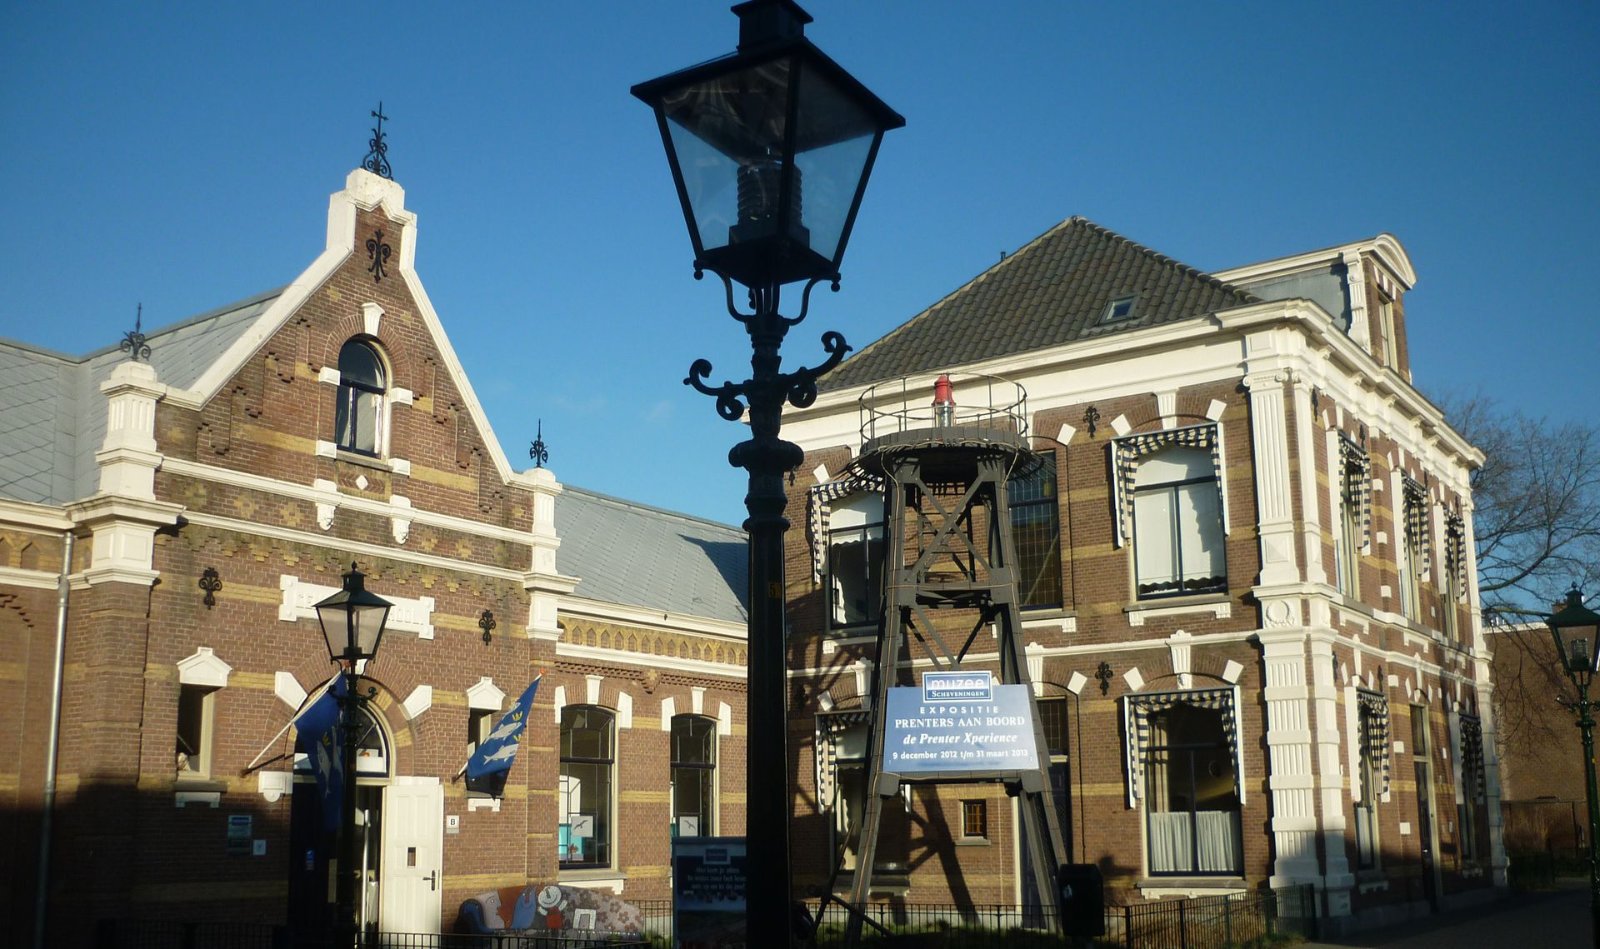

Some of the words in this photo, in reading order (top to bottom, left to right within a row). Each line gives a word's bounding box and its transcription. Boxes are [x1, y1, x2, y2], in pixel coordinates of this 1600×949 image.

[931, 678, 985, 689] muzee
[920, 706, 999, 714] EXPOSITIE
[895, 718, 954, 729] PRENTERS
[958, 717, 982, 727] AAN
[986, 716, 1025, 726] BOORD
[903, 734, 917, 745] de
[920, 733, 960, 744] Prenter
[963, 732, 1018, 745] Xperience
[892, 752, 898, 760] 9
[900, 751, 938, 760] december
[940, 750, 957, 759] 2012
[960, 750, 974, 760] t/m
[976, 750, 984, 758] 31
[986, 749, 1009, 758] maart
[1011, 749, 1028, 757] 2013
